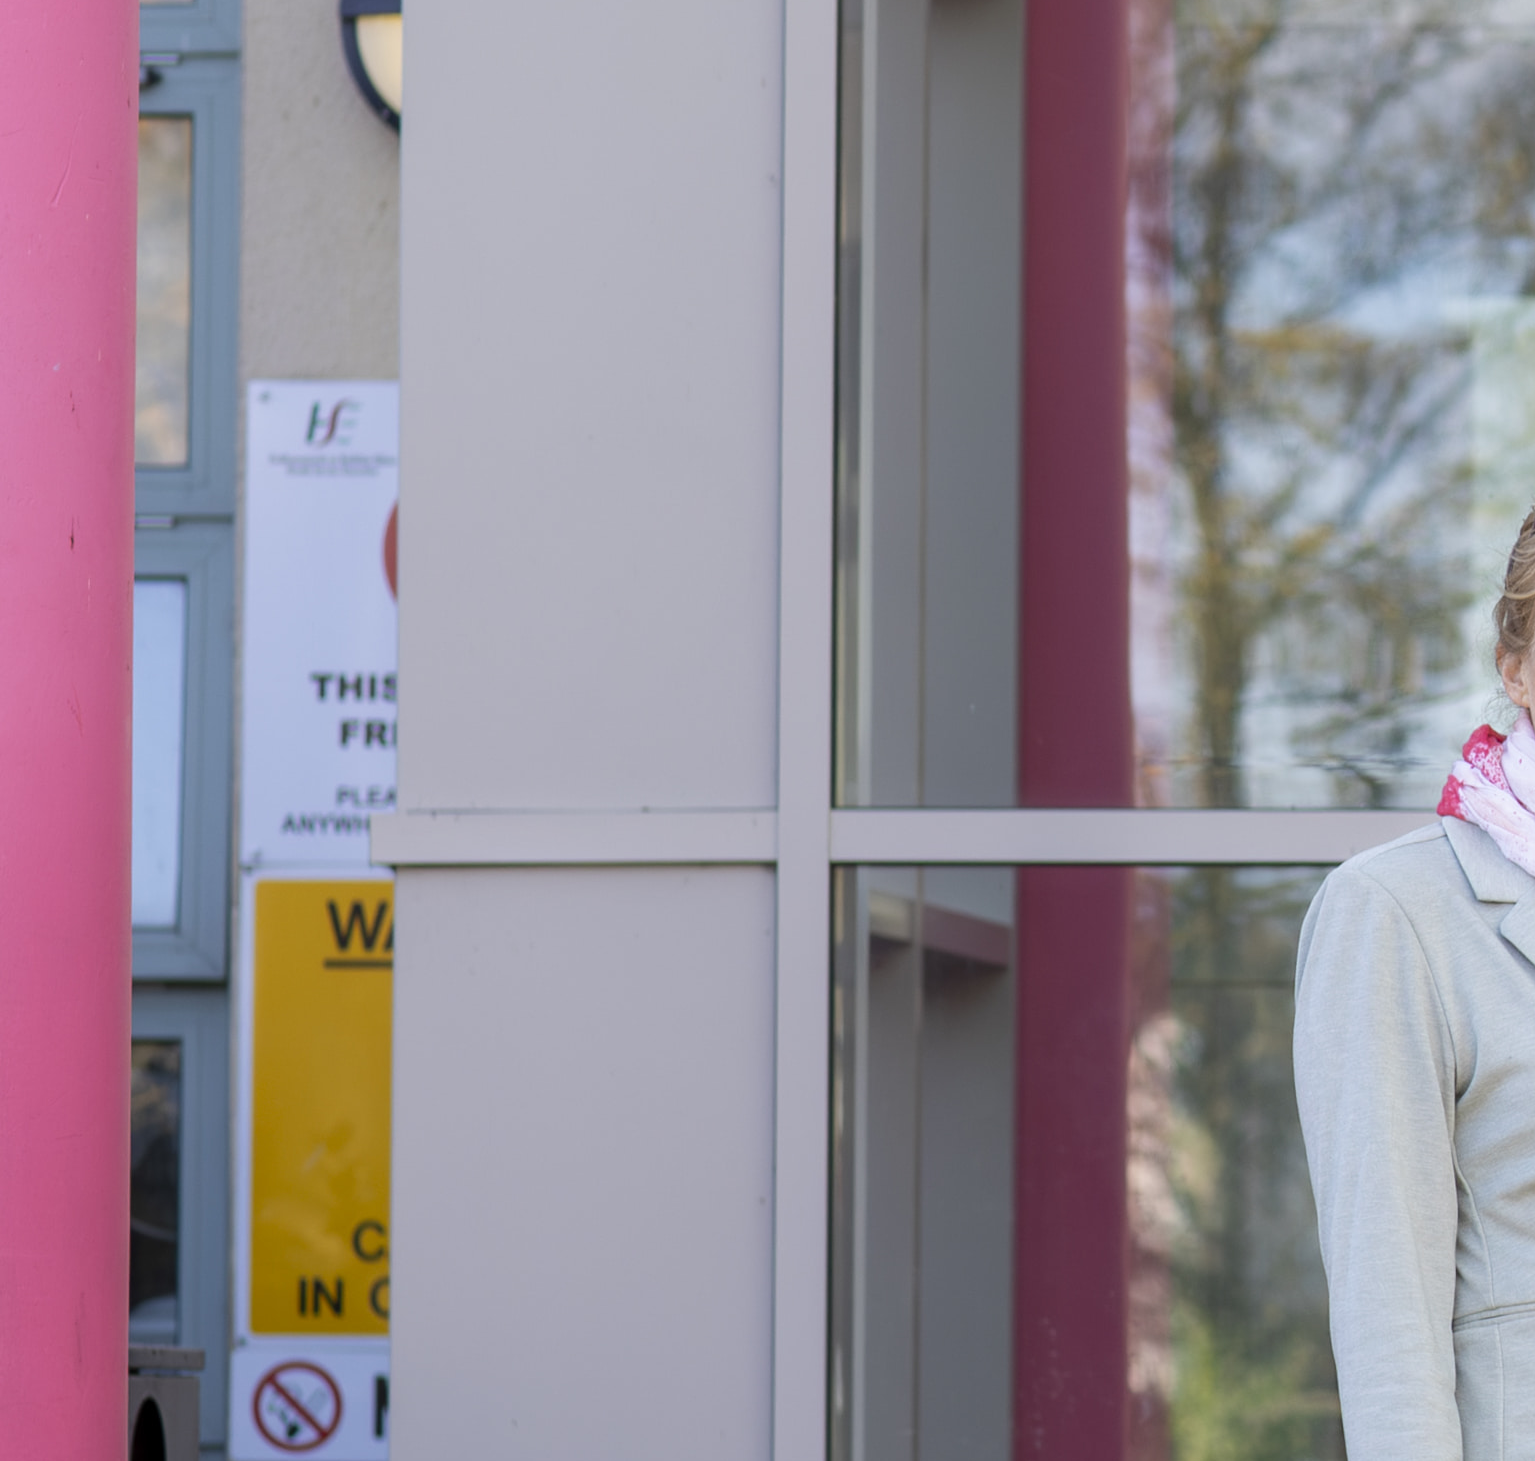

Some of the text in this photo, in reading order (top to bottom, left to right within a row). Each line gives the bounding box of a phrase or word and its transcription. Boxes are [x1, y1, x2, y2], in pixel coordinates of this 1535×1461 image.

[311, 672, 396, 701] THIS
[341, 720, 396, 747] FR
[299, 1277, 342, 1316] IN
